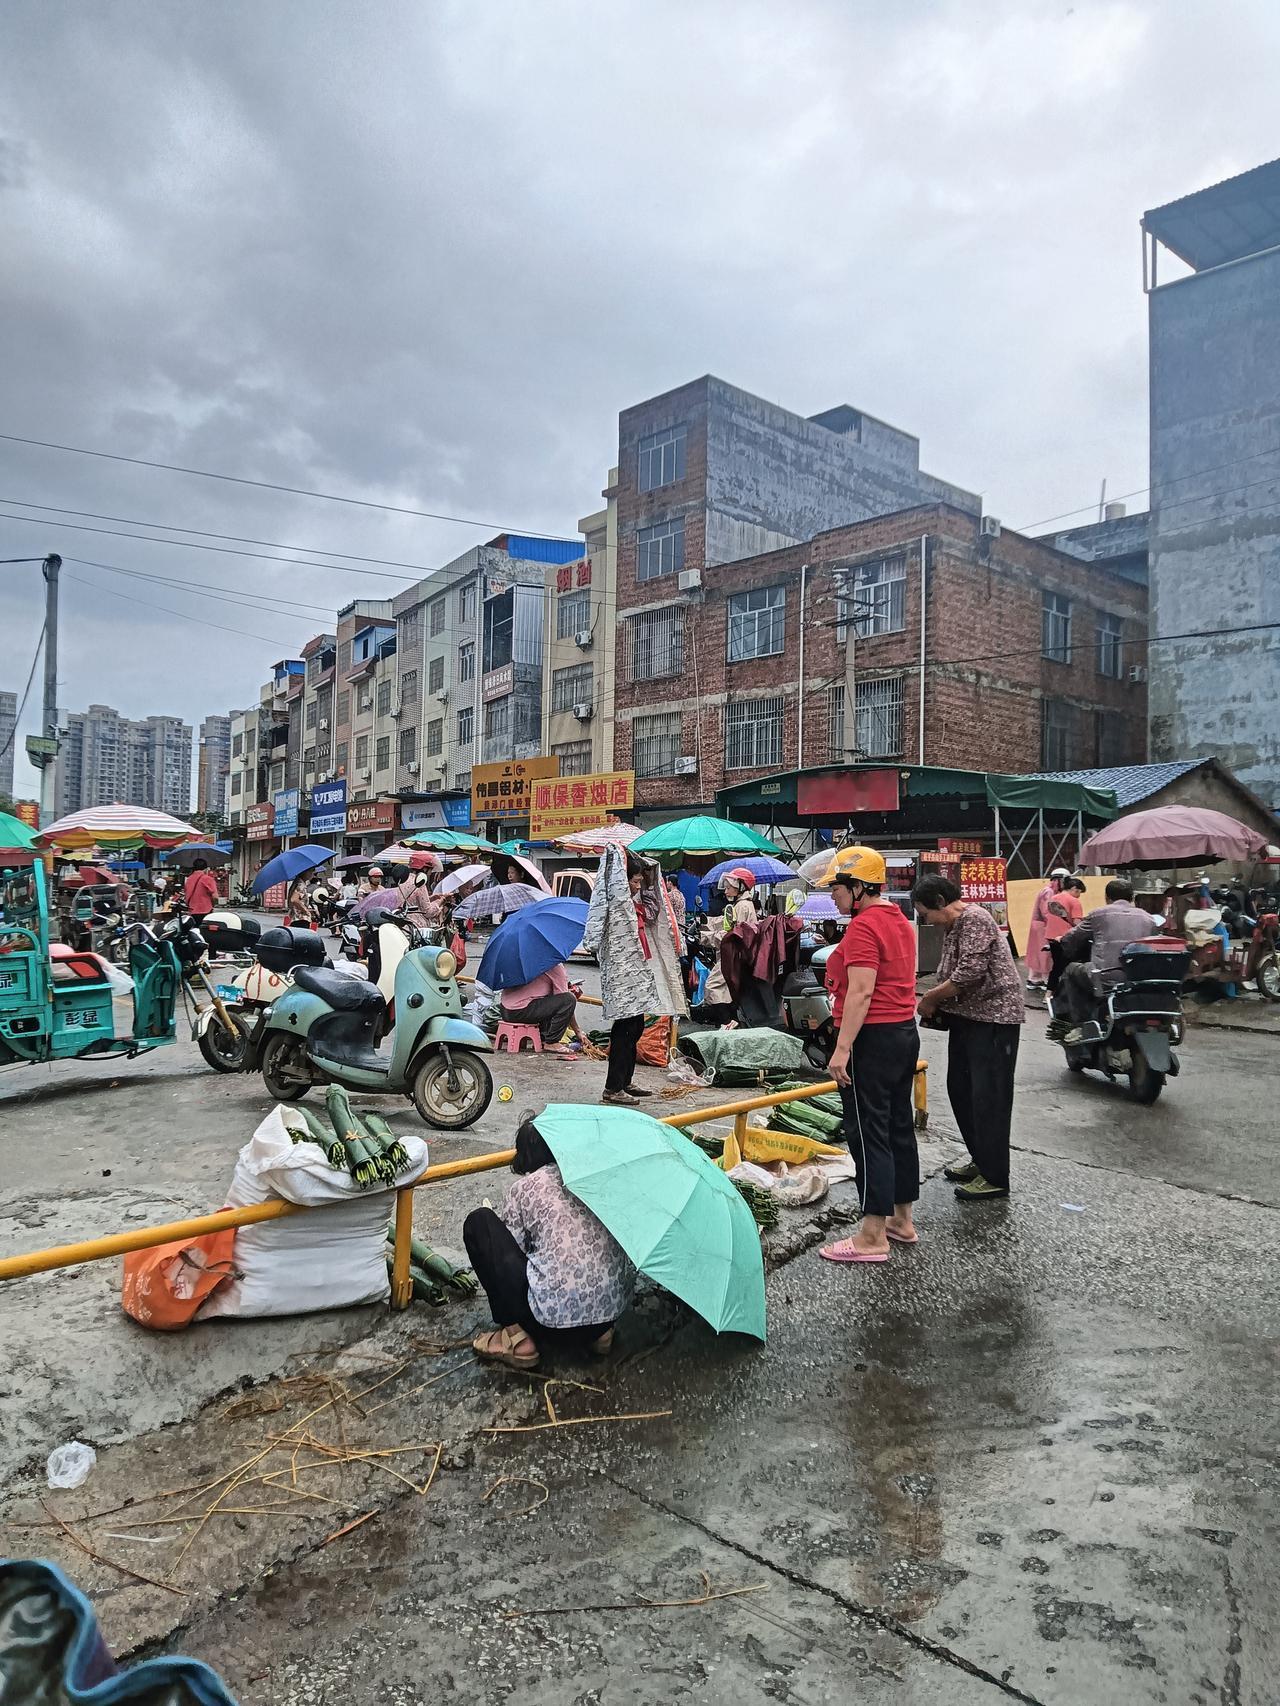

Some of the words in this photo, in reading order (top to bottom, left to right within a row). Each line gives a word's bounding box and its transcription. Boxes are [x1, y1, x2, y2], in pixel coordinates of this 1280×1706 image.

[556, 560, 592, 593] 烟酒
[535, 779, 628, 811] 顺保香烛店
[960, 883, 1005, 899] 玉林炒牛料
